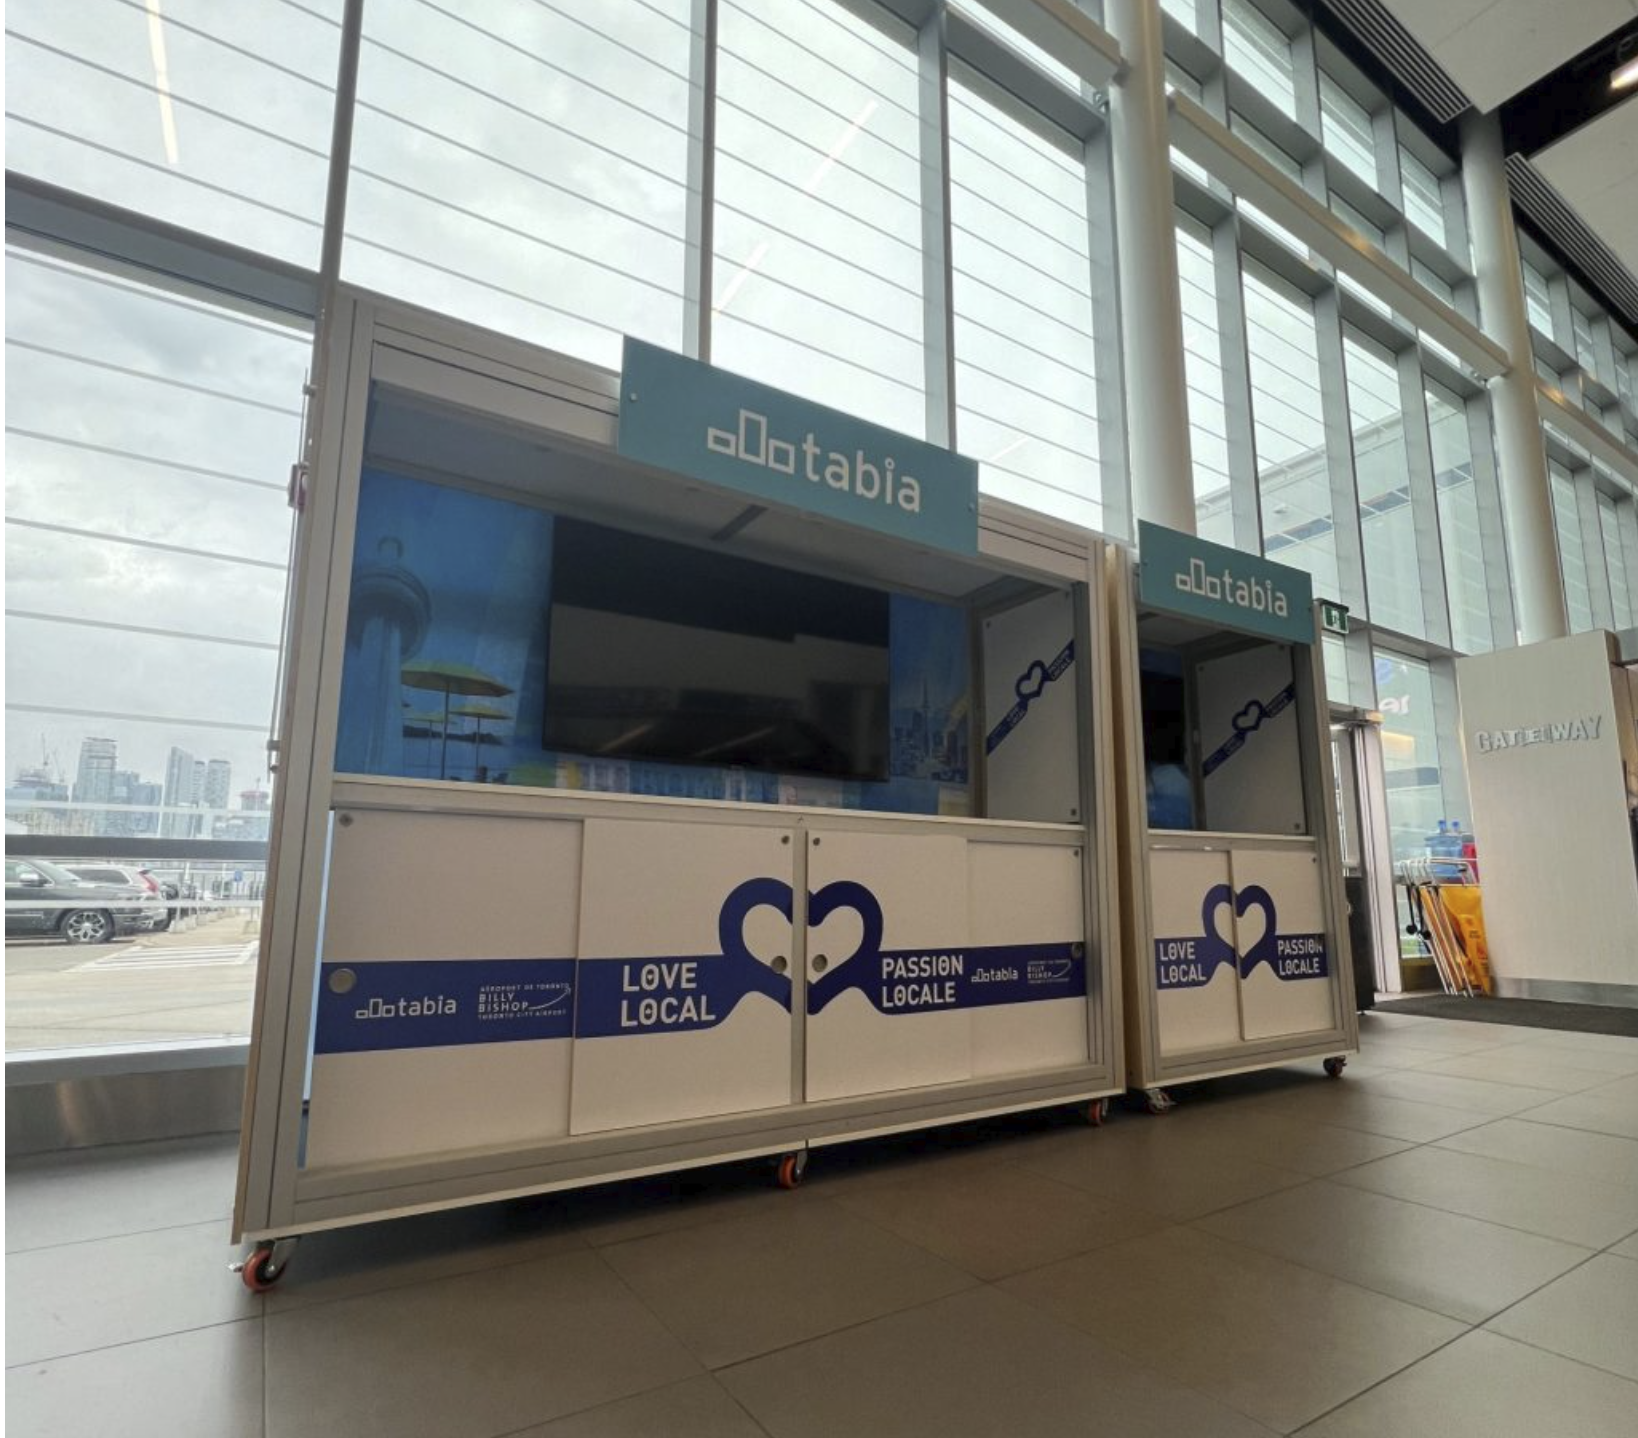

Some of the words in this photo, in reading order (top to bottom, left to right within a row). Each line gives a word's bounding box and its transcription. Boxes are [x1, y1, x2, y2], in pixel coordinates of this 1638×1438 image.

[801, 432, 922, 513] tabia
[1222, 568, 1289, 618] tabia
[1475, 714, 1602, 755] GATEWAY
[1159, 941, 1196, 961] LOVE
[622, 962, 698, 992] LOVE
[882, 954, 964, 980] PASSION
[1161, 963, 1207, 984] LOCAL
[1279, 957, 1321, 976] LOCALE
[398, 995, 457, 1017] tabia
[478, 1001, 529, 1013] BISHOP
[479, 992, 515, 1003] BILLY
[882, 981, 957, 1008] LOCALE
[620, 995, 717, 1027] LOCAL
